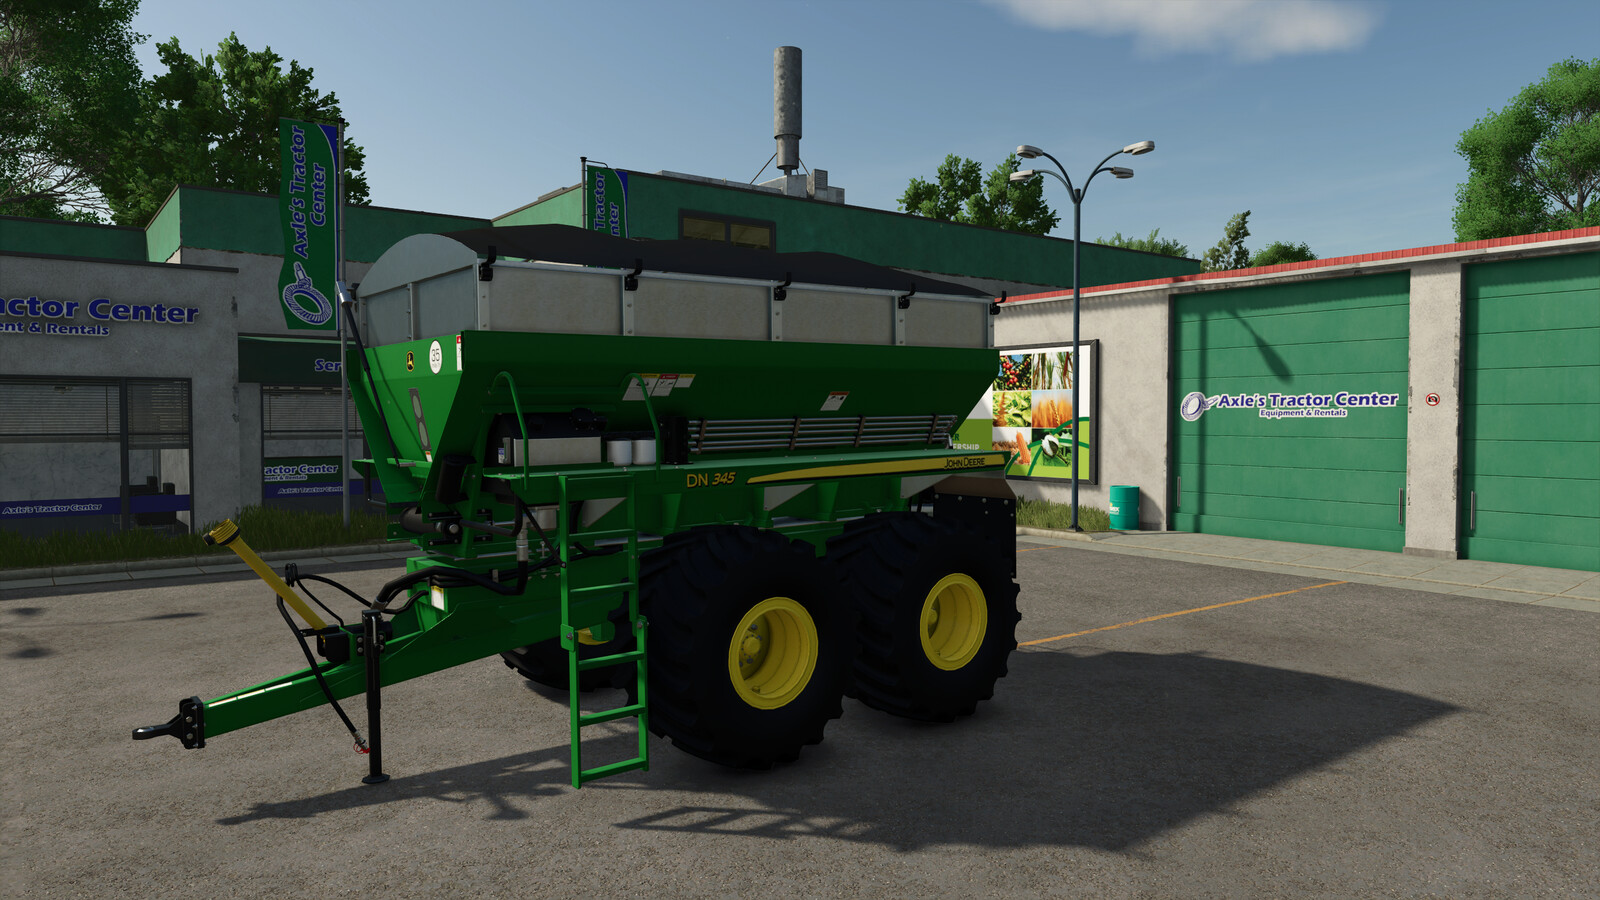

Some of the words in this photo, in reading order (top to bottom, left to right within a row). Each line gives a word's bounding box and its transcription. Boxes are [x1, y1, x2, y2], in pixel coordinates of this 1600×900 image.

[290, 125, 306, 194] Tractor
[310, 163, 326, 226] Center
[594, 171, 605, 231] Tractor
[609, 202, 620, 236] nter
[290, 198, 308, 258] Axle's
[88, 299, 199, 323] Center
[28, 322, 42, 333] &
[46, 323, 110, 336] Rentals
[432, 349, 440, 362] 35
[314, 359, 341, 372] Ser
[1218, 394, 1266, 408] Axle's
[1269, 393, 1332, 408] Tractor
[1335, 392, 1399, 407] Center
[1260, 409, 1304, 418] Equipment
[1305, 409, 1312, 417] &
[1314, 409, 1347, 417] Rentals
[299, 464, 339, 475] Center
[686, 472, 709, 489] DN
[711, 471, 737, 486] 345
[34, 505, 69, 513] Tractor
[70, 503, 102, 512] Center
